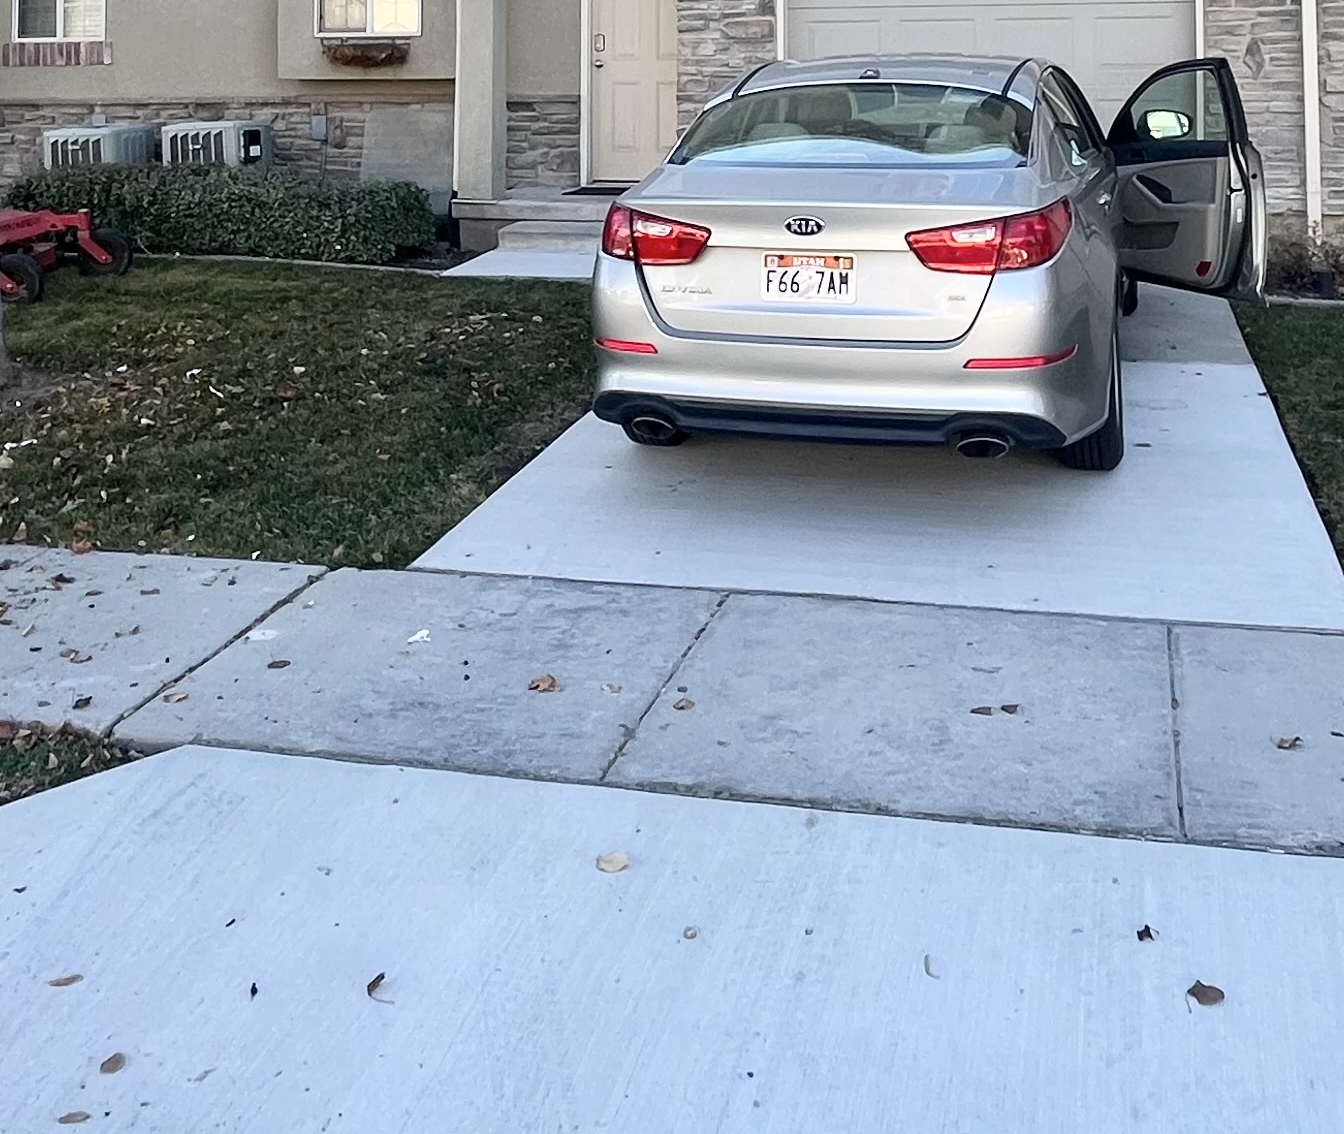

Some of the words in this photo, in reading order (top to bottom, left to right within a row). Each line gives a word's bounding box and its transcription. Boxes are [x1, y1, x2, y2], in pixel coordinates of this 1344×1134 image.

[789, 219, 819, 233] KIA
[793, 256, 825, 267] UTAH
[766, 270, 800, 293] F66
